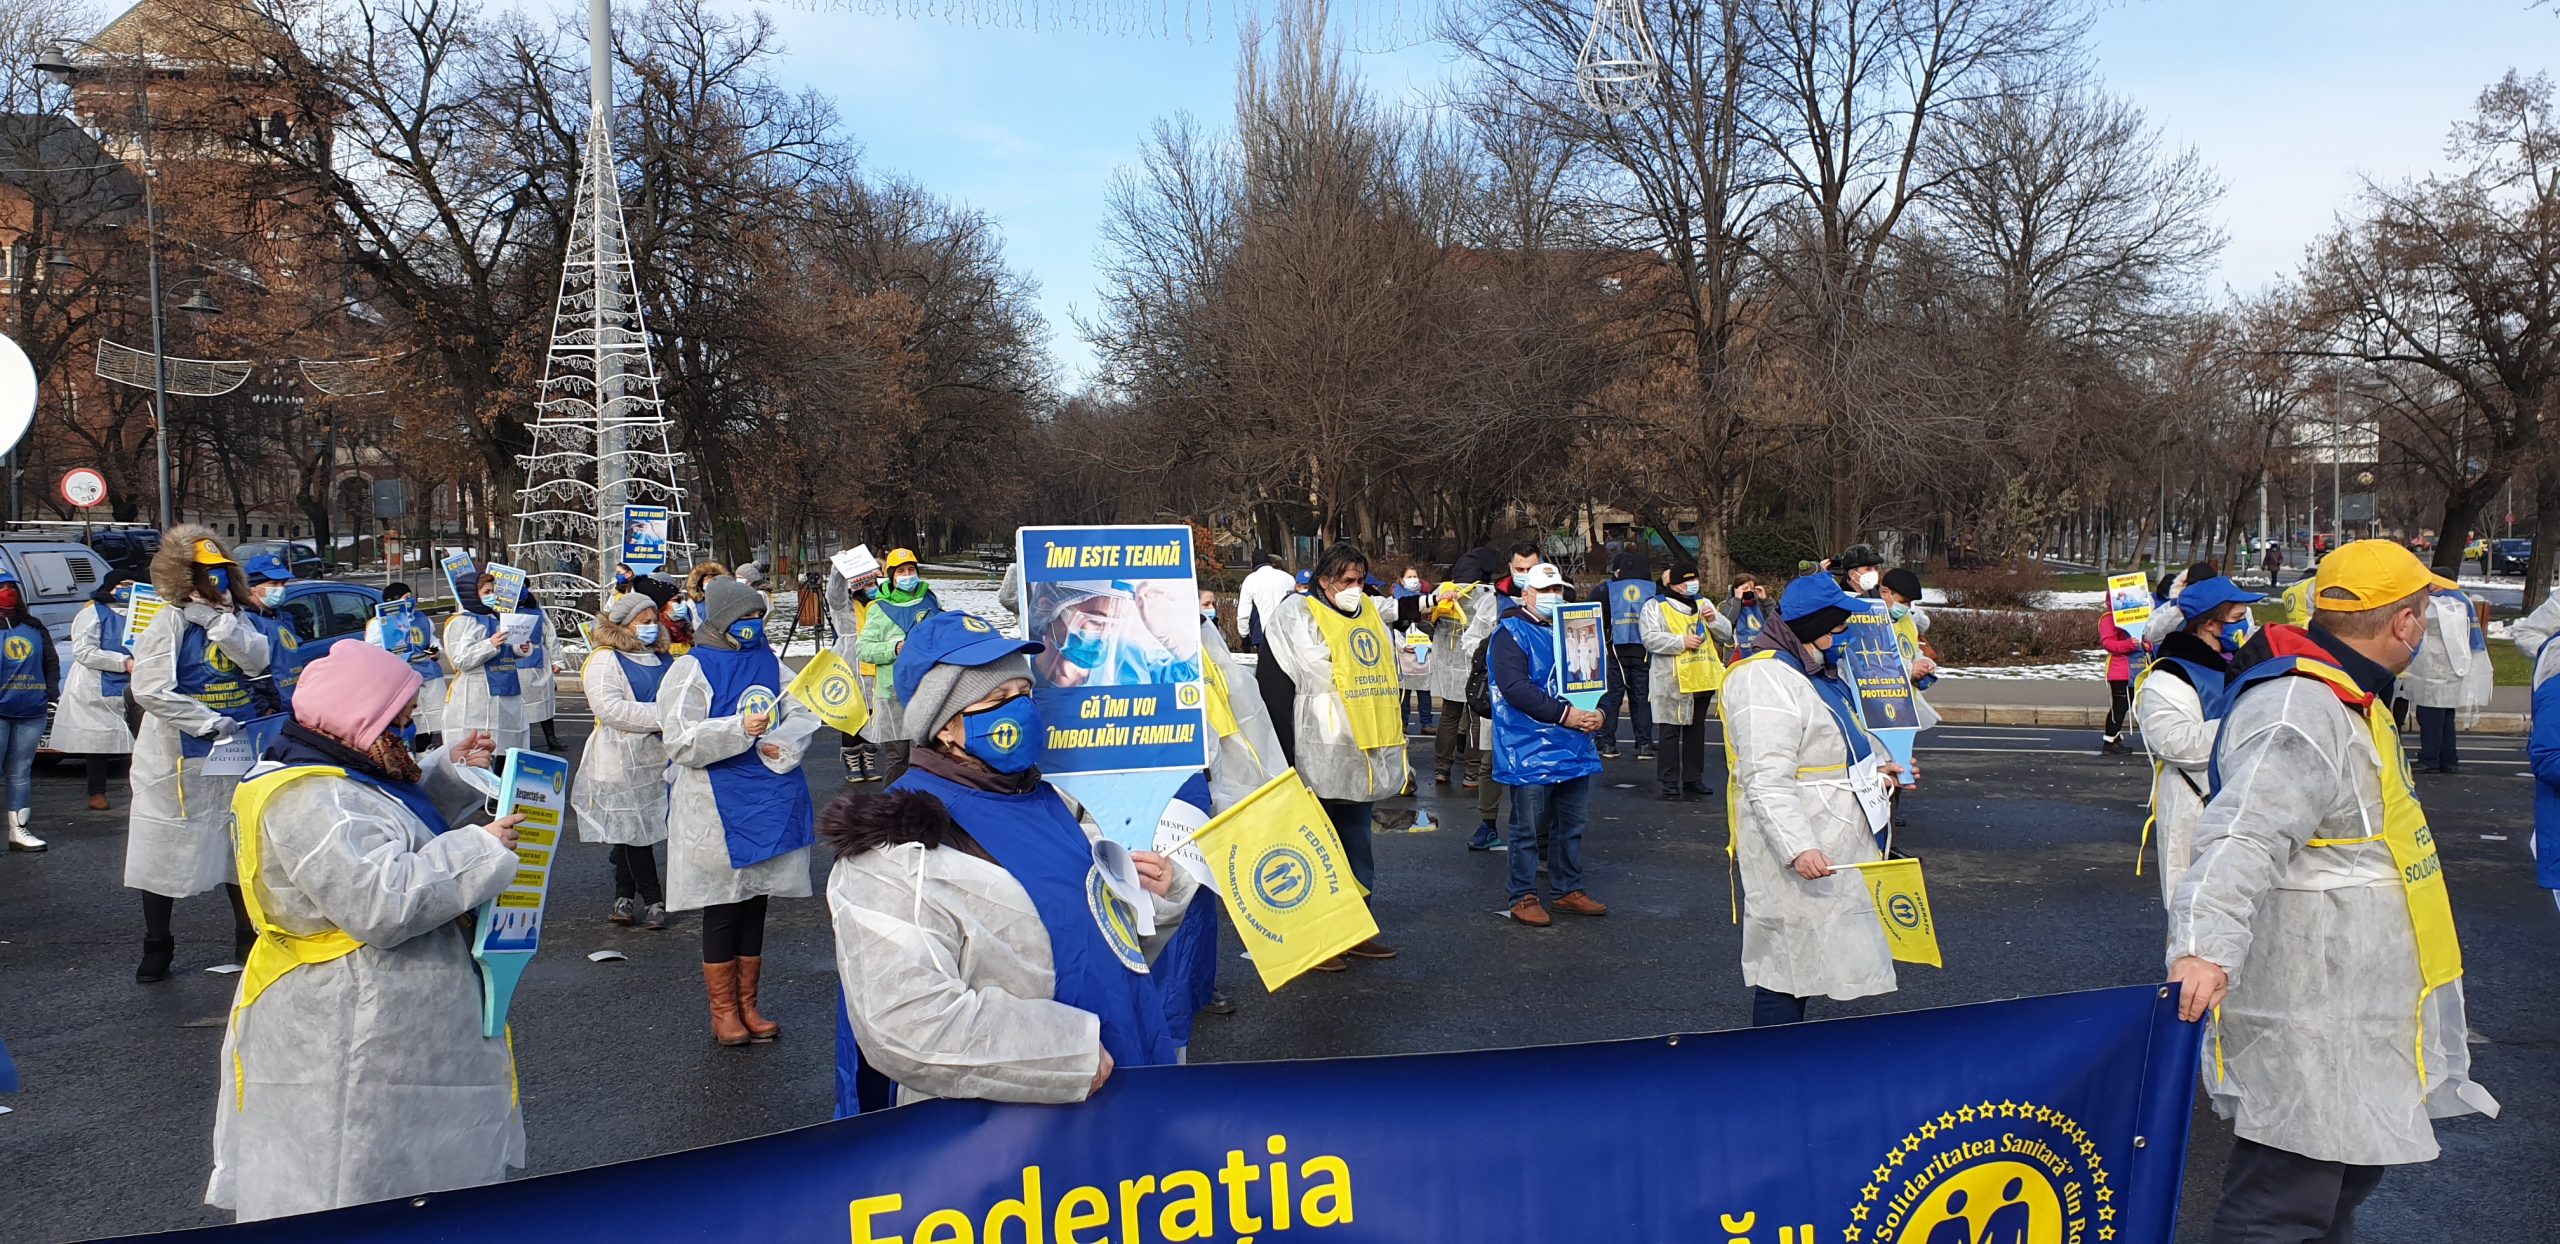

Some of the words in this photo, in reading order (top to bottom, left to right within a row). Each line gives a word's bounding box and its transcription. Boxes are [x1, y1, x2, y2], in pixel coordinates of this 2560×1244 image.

[1044, 541, 1077, 568] ÎMI
[1080, 545, 1120, 567] ESTE
[1125, 540, 1181, 567] TEAMĂ
[1857, 678, 1867, 687] pe
[1868, 676, 1879, 685] cei
[1080, 695, 1102, 718] CĂ
[1102, 694, 1130, 718] ÎMI
[1133, 697, 1157, 716] VOI
[1047, 723, 1129, 749] ÎMBOLNĂVI
[1132, 724, 1196, 746] FAMILIA!
[1228, 844, 1247, 914] SOLIDARITATEA
[1245, 913, 1284, 944] SANITARĂ
[849, 1133, 1354, 1244] Federația
[2063, 1180, 2083, 1215] din
